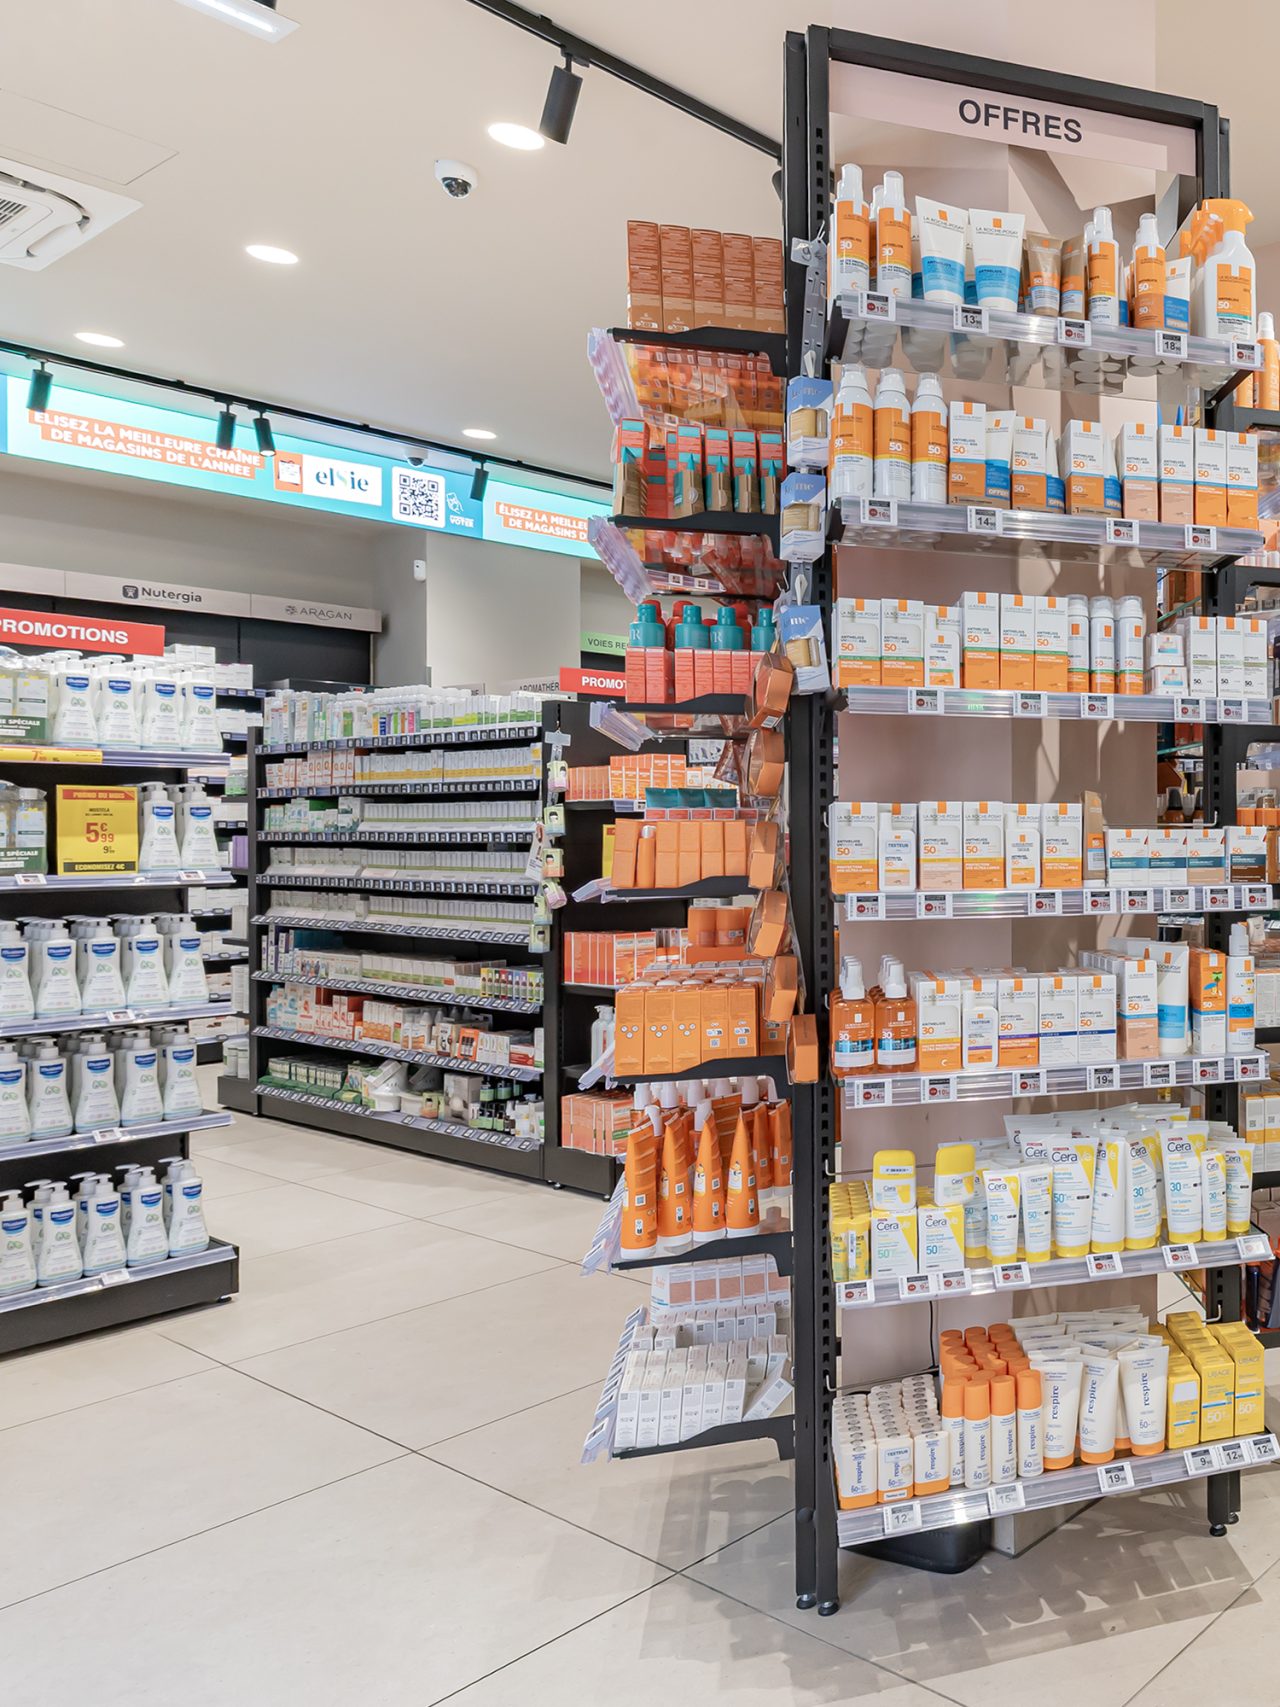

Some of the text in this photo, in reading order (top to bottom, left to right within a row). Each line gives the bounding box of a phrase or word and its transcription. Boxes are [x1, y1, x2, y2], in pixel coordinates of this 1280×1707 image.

[958, 98, 1083, 144] OFFRES
[50, 428, 72, 443] DE
[77, 433, 162, 460] MAGASINS
[166, 451, 186, 464] DE
[94, 423, 115, 438] LA
[119, 427, 202, 454] MEILLEURE
[206, 446, 261, 468] CHAÎNE
[498, 504, 589, 531] ÉLISEZ LA MEILLEU
[509, 518, 524, 528] DE
[525, 521, 577, 539] MAGASINS
[141, 587, 203, 604] Nutergia
[299, 606, 353, 622] ARAGAN
[587, 637, 613, 649] VOIES
[519, 681, 560, 692] AROMATHER
[581, 675, 626, 690] PROMO
[921, 1026, 935, 1035] 30
[1170, 1182, 1182, 1192] 30
[1051, 1385, 1059, 1420] respire
[1087, 1379, 1098, 1414] respire
